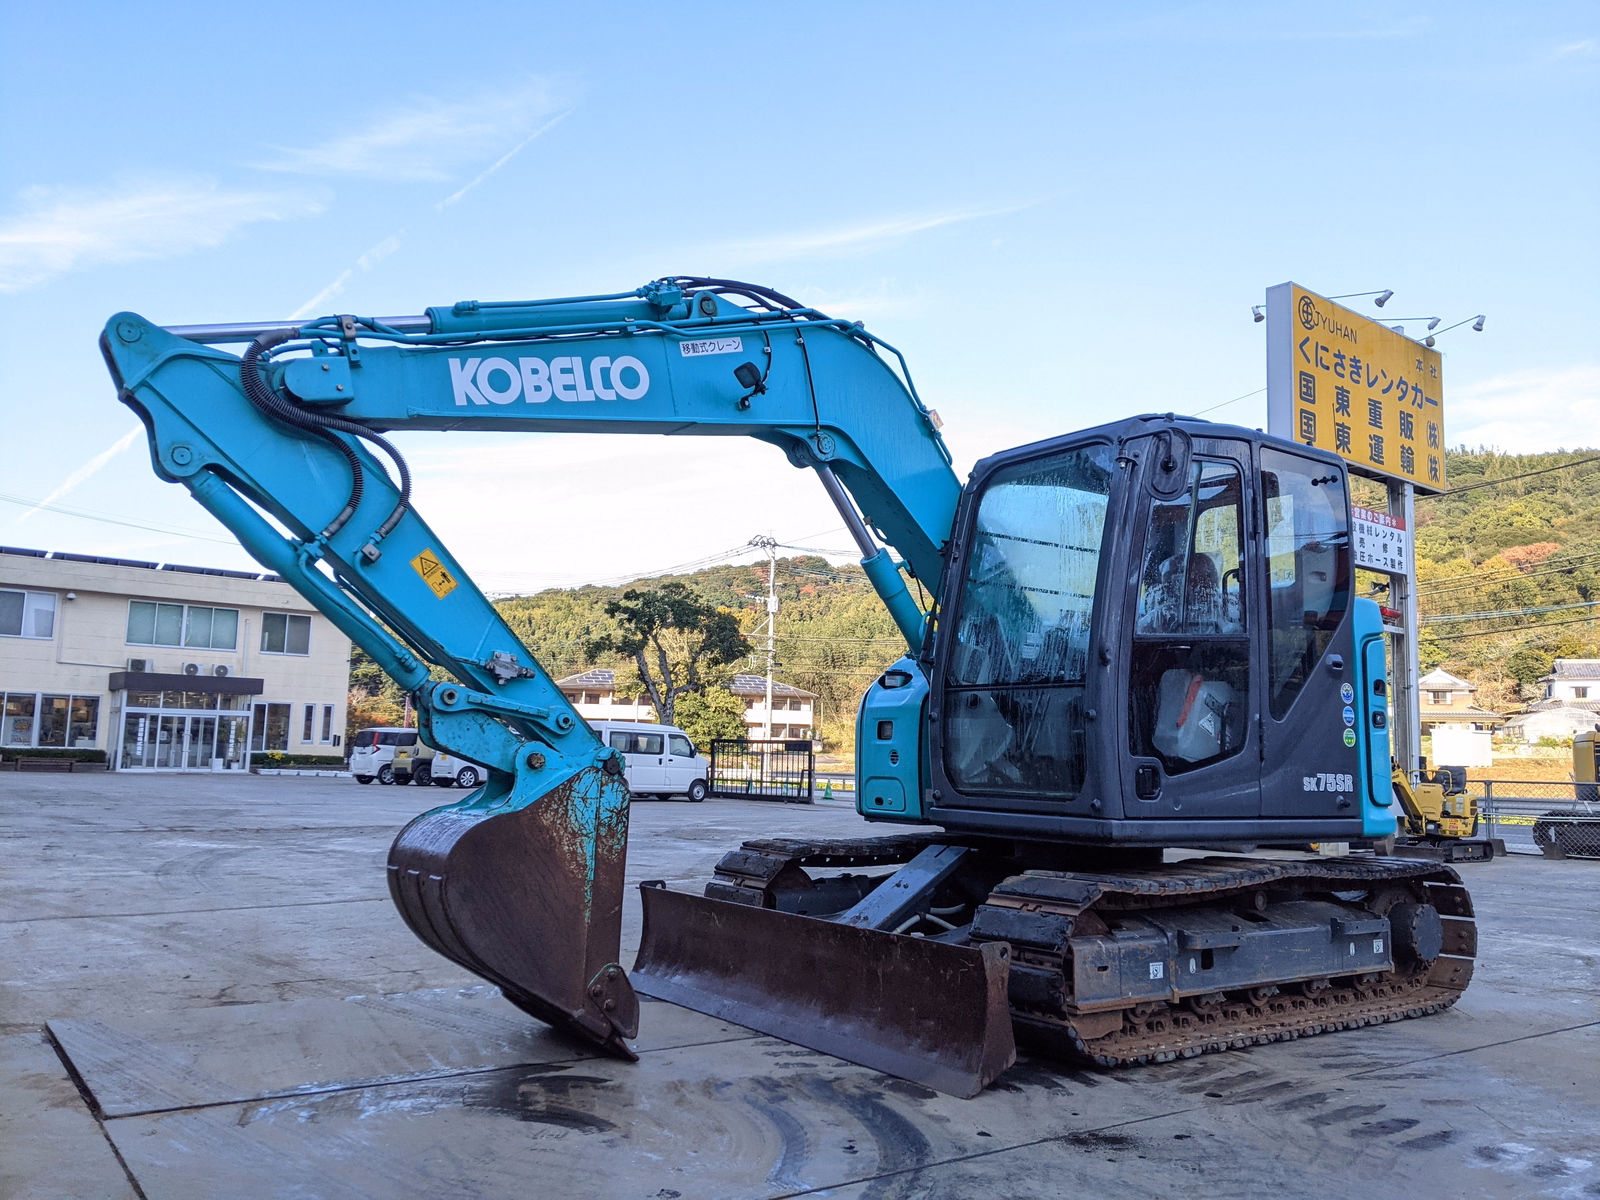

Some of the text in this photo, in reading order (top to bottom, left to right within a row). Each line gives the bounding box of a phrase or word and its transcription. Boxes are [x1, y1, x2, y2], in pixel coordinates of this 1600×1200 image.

[1314, 311, 1357, 344] JYUHAN
[681, 339, 741, 355] 移動式クレーン
[448, 355, 650, 406] KOBELCO
[1299, 336, 1439, 410] くにさきレンタカー
[1303, 773, 1354, 792] SK75SR
